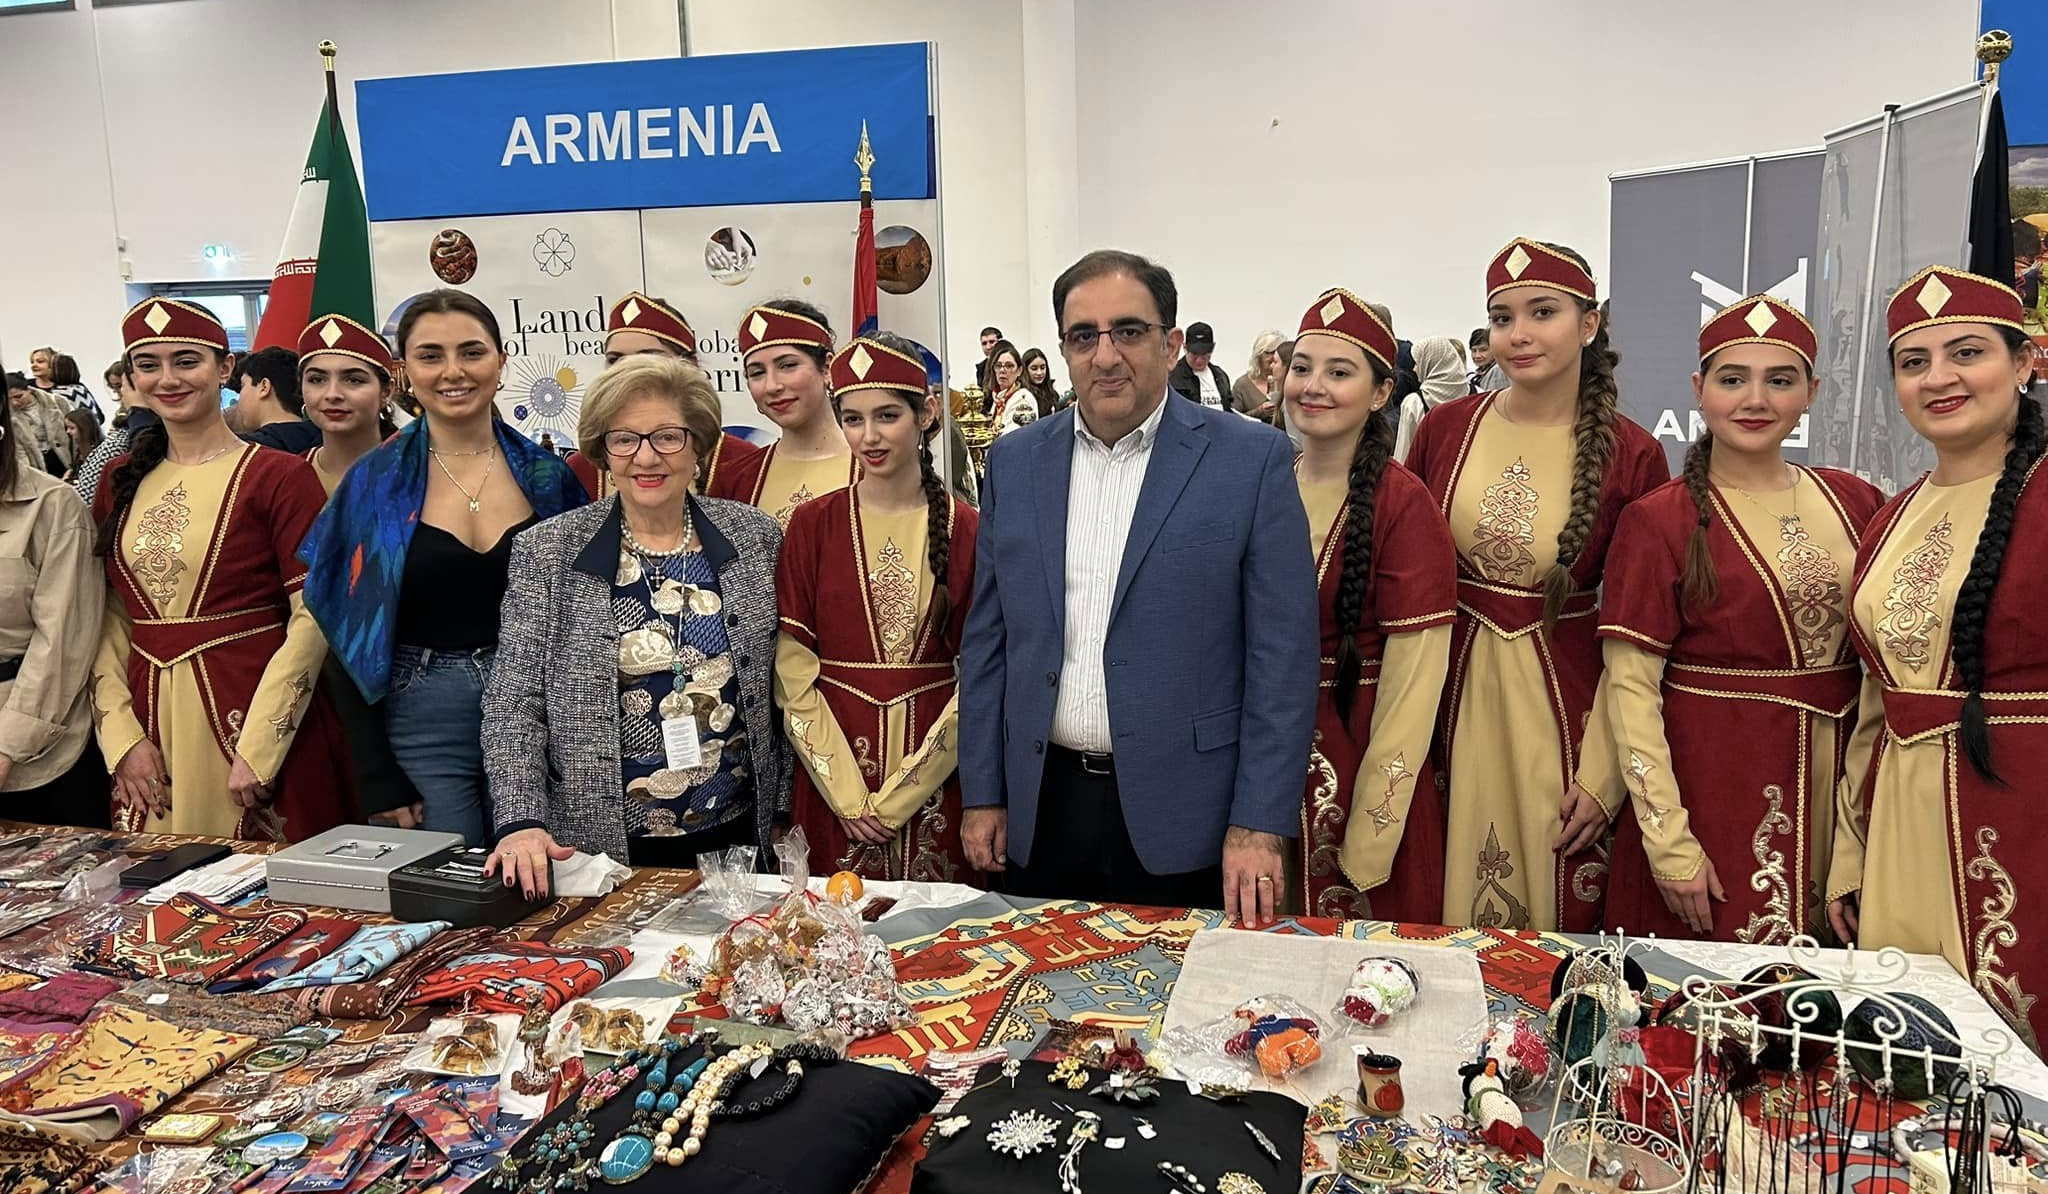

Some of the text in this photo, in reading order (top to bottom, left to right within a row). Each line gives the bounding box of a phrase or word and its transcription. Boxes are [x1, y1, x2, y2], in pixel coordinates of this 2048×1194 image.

[500, 102, 782, 166] ARMENIA
[508, 296, 608, 334] Land
[504, 324, 530, 357] of
[562, 333, 606, 356] bea
